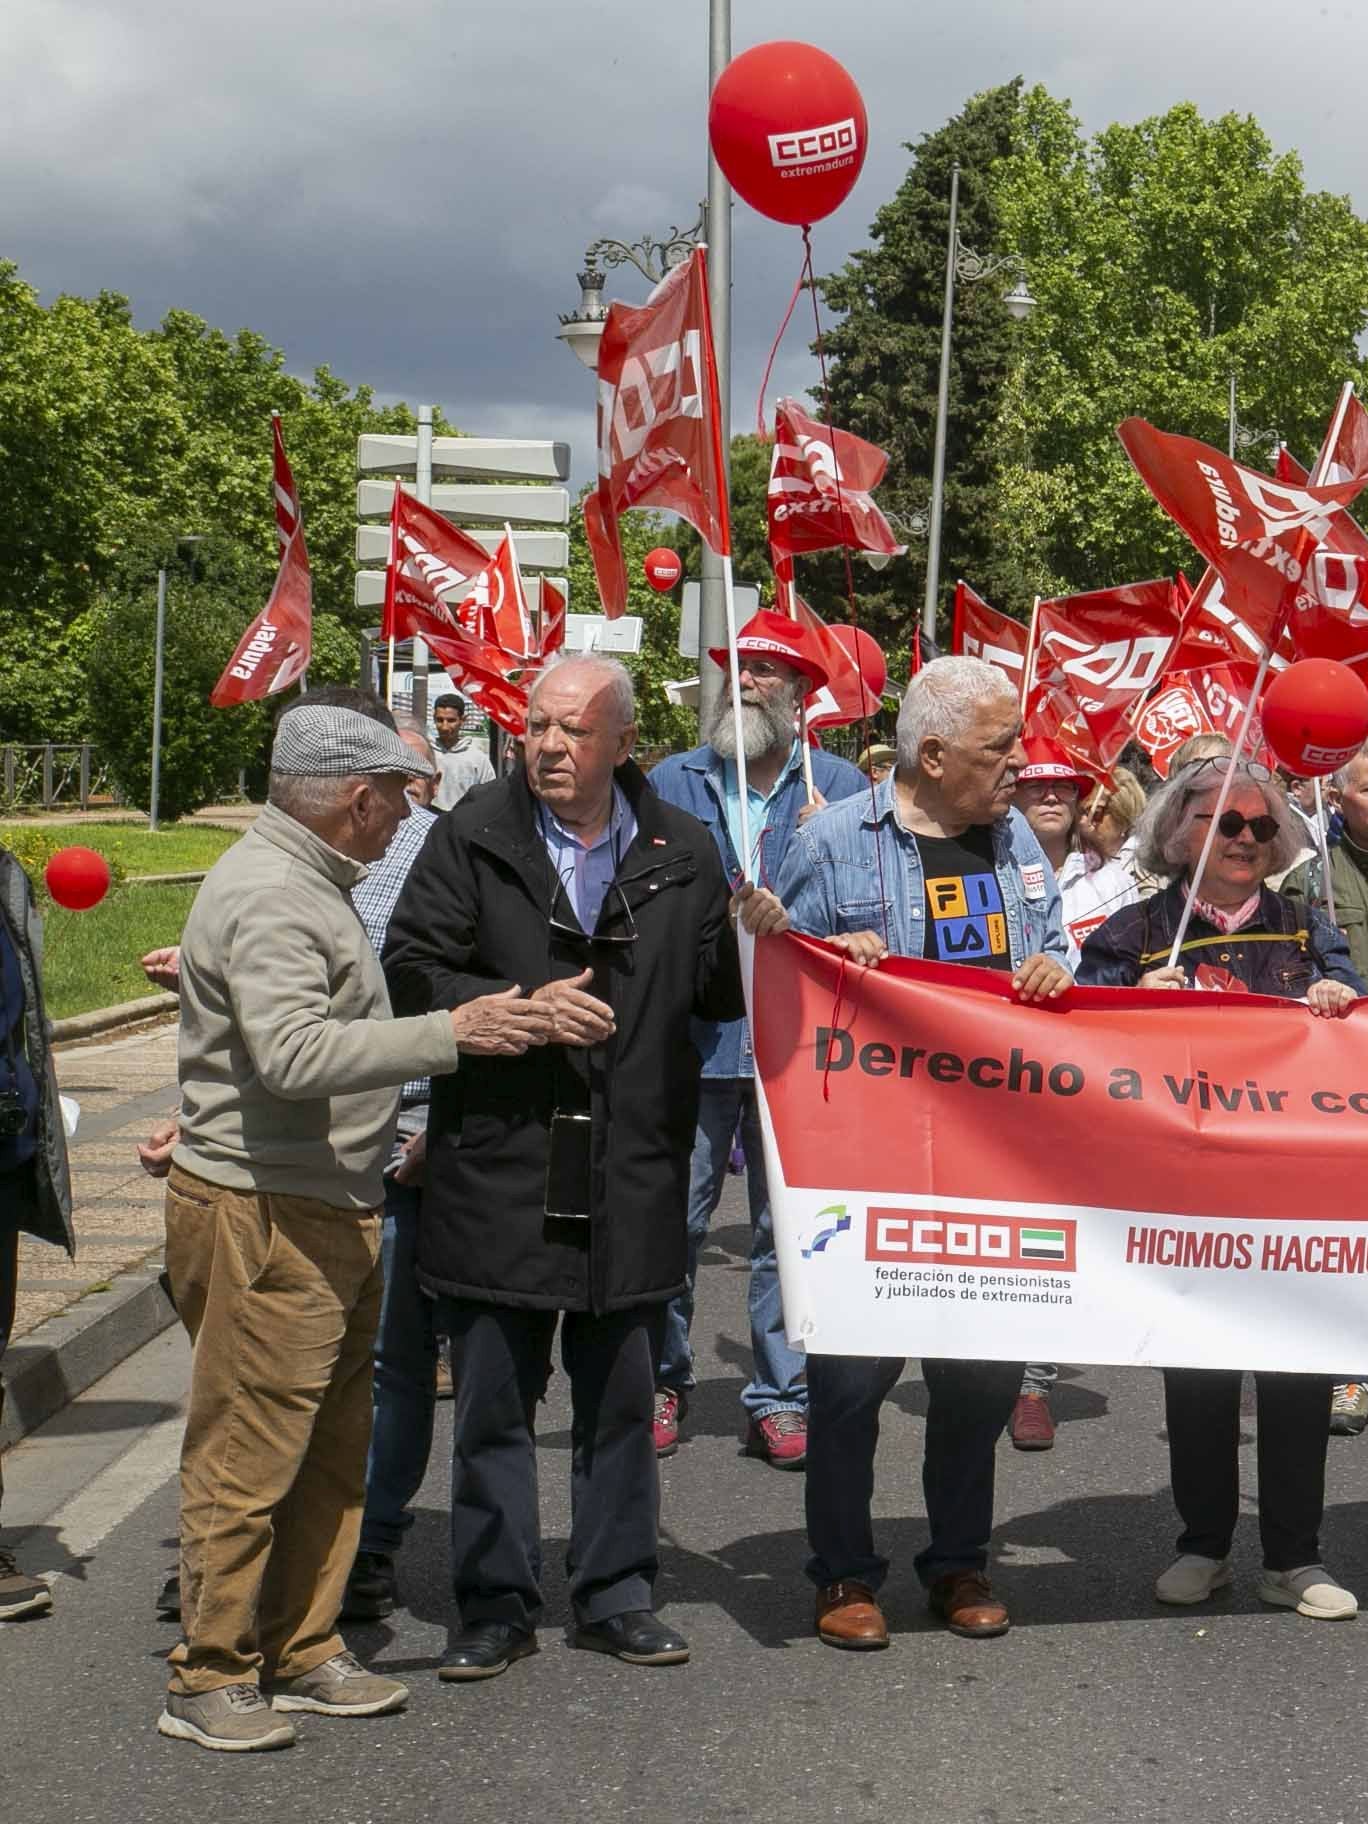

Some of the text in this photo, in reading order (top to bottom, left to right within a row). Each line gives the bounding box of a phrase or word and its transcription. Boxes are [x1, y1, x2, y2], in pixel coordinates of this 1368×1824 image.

[764, 125, 854, 161] CCOO
[780, 155, 855, 178] extremadura
[815, 1026, 1085, 1097] Derecho
[1108, 1067, 1144, 1100] a
[1164, 1072, 1289, 1112] vivir
[875, 1217, 1011, 1258] CCOO
[1126, 1226, 1254, 1269] HICIMOS
[874, 1283, 1072, 1305] y jubilados de extremadura
[875, 1266, 1071, 1290] federación de pensionistas
